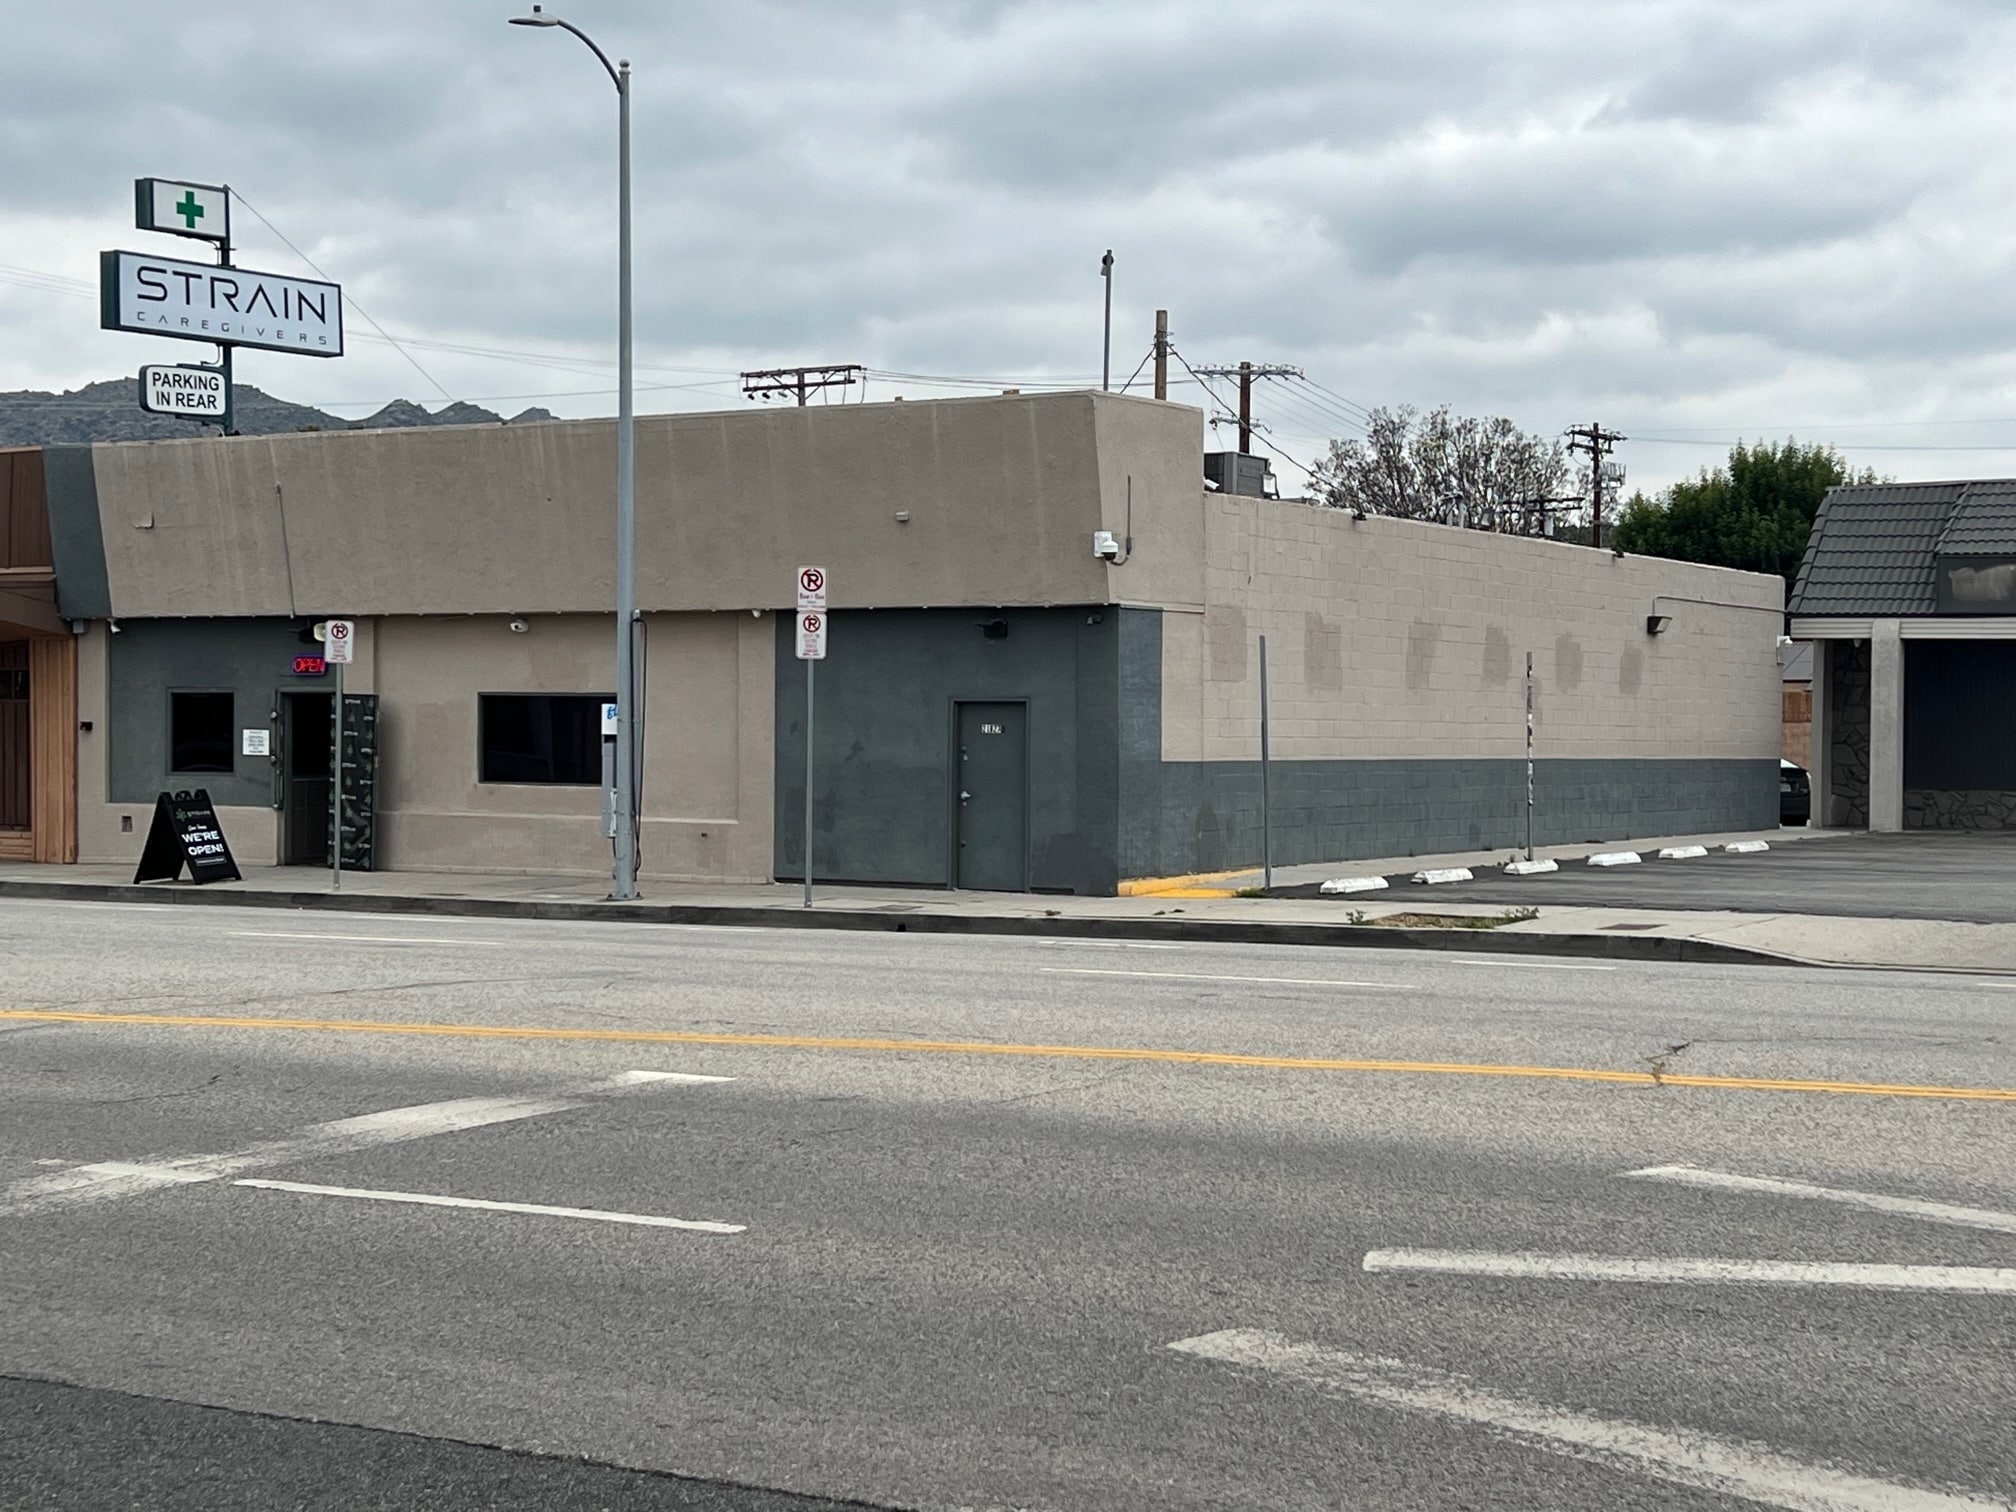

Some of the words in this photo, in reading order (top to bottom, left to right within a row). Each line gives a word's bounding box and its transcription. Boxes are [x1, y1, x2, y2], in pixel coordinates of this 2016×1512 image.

[137, 266, 326, 325] STRAIN
[137, 311, 327, 345] CAREGIVERS
[152, 371, 220, 391] PARKING
[156, 391, 171, 406] IN
[175, 392, 218, 410] REAR
[294, 658, 325, 672] OPEN
[181, 830, 220, 843] WE'RE
[187, 844, 225, 856] OPEN!
